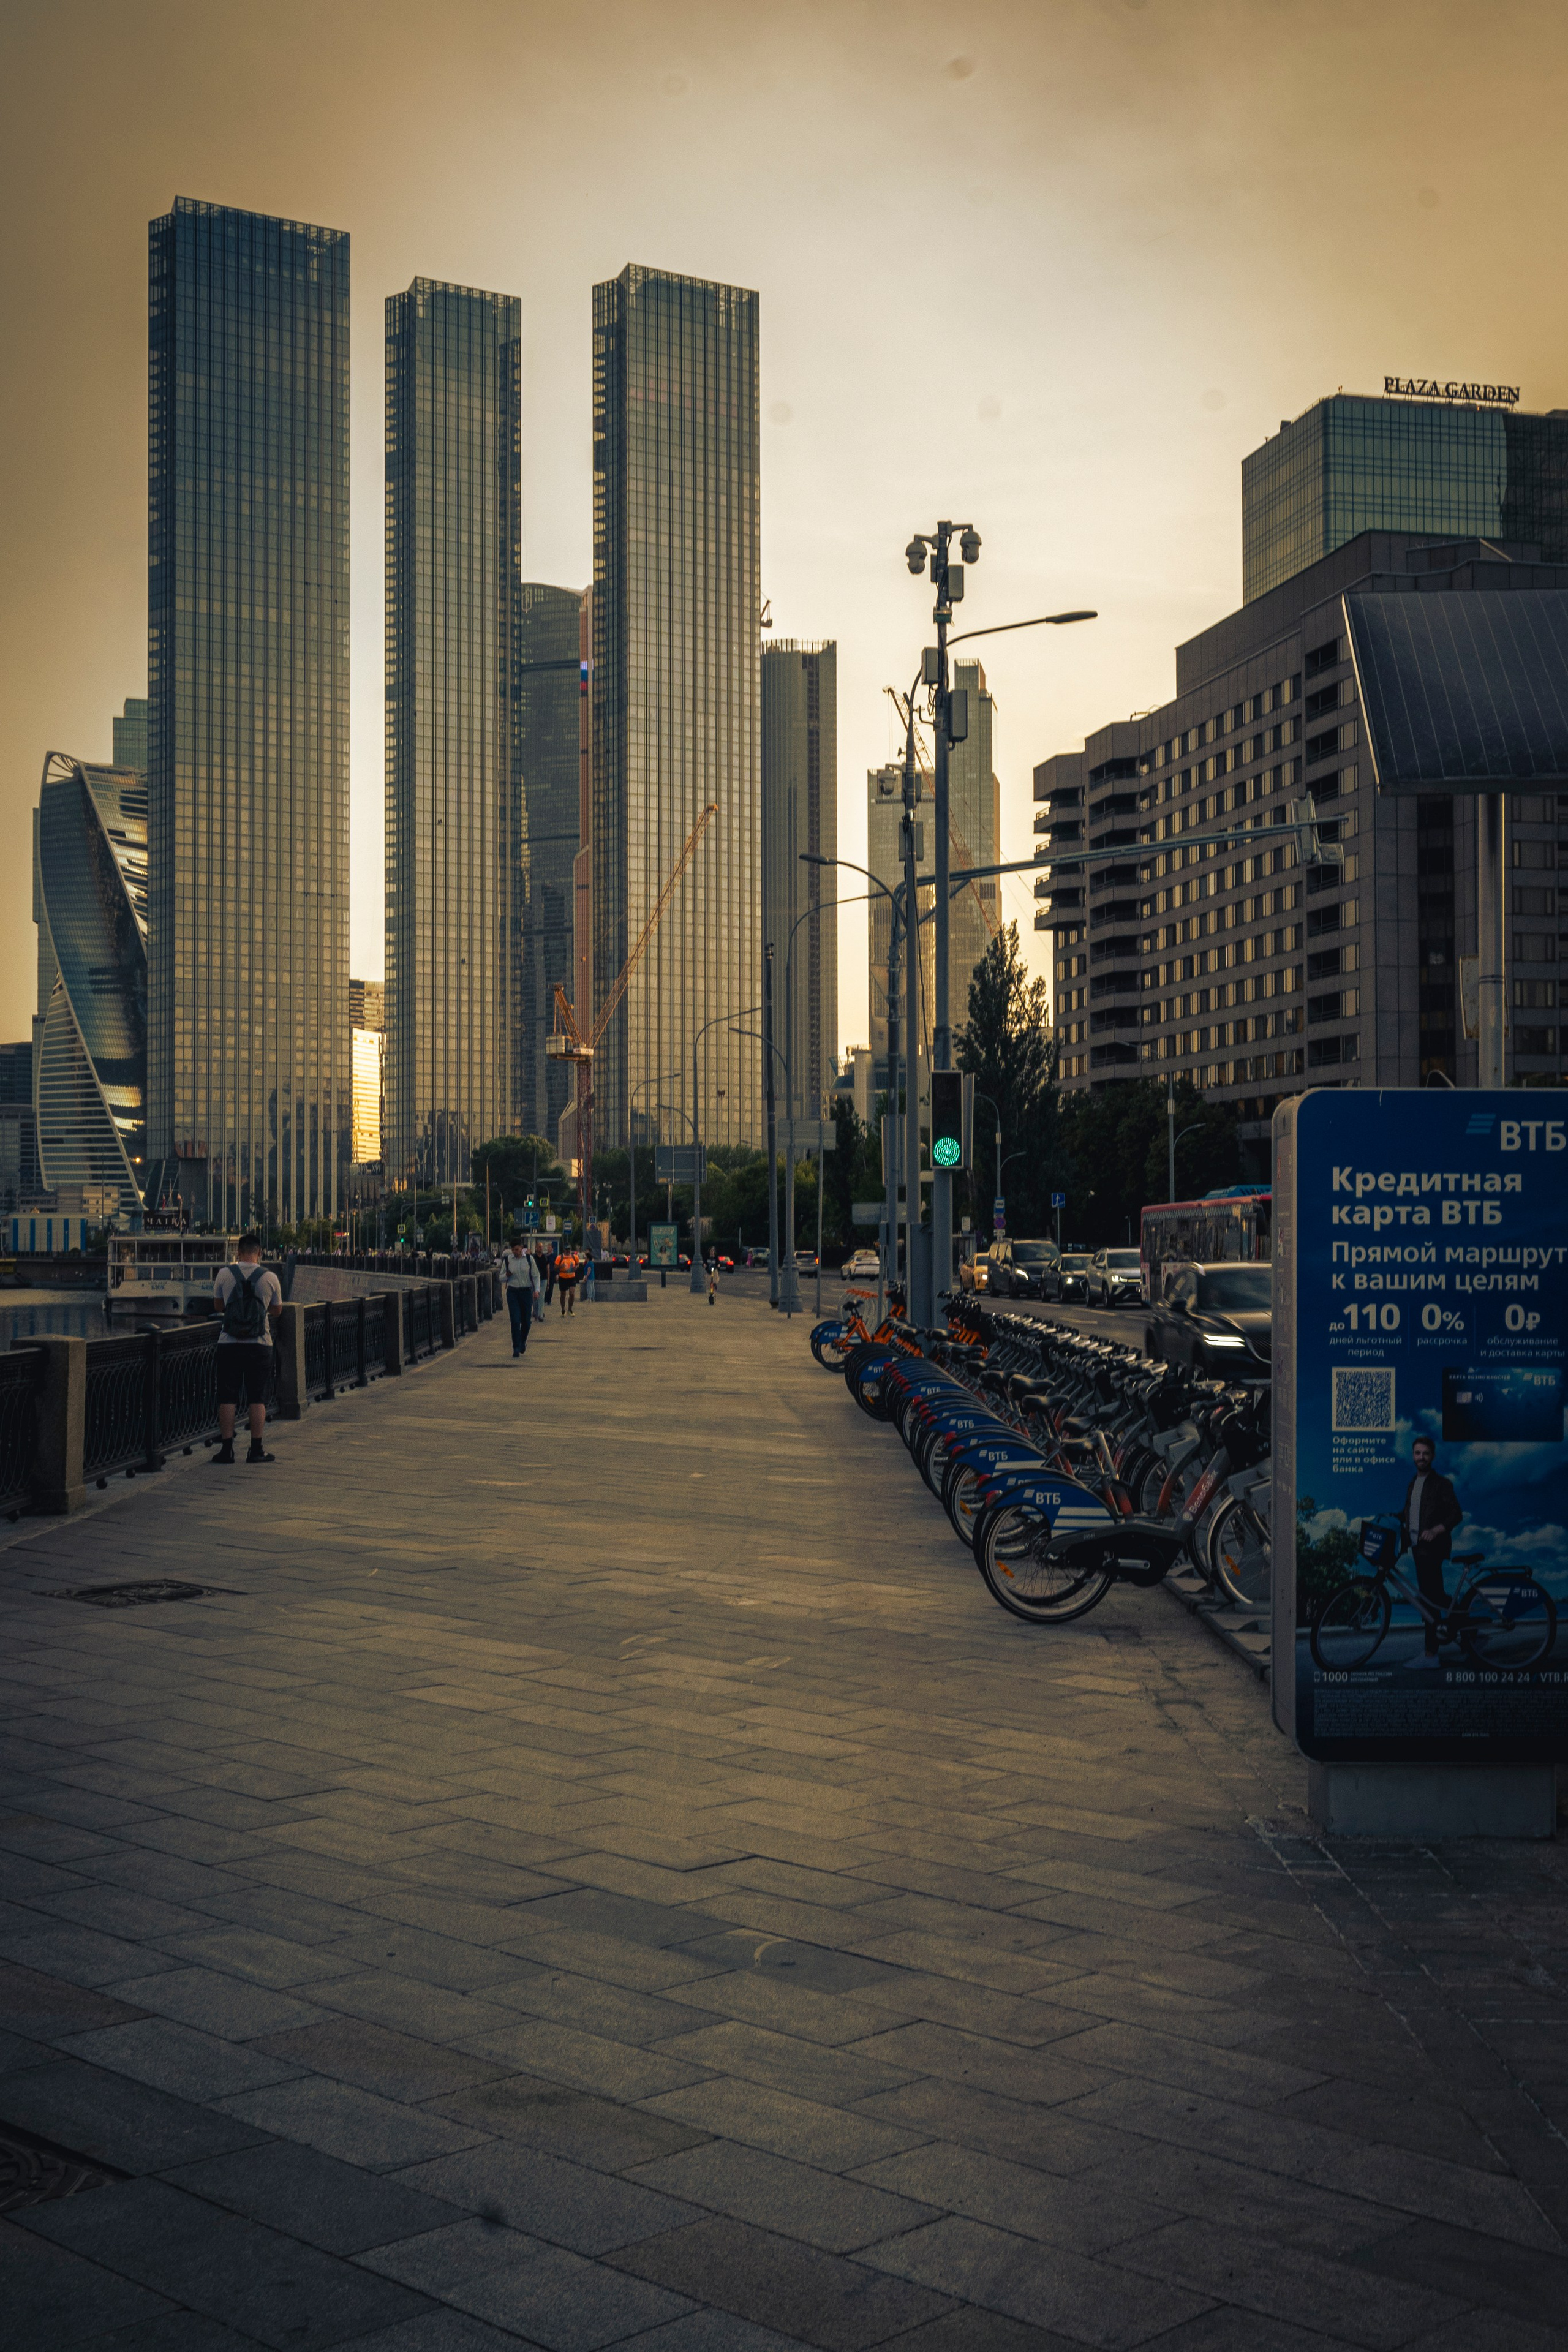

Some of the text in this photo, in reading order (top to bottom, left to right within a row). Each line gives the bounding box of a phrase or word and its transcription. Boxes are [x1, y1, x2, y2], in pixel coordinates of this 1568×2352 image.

[1384, 376, 1521, 402] PLAZA GARDEN
[1501, 1120, 1567, 1152] ВТБ
[1332, 1166, 1522, 1198] Кредитная
[1332, 1200, 1502, 1231] карта ВТБ
[1332, 1242, 1567, 1268] Прямой маршрут
[1332, 1273, 1539, 1293] к вашим целям
[1329, 1303, 1401, 1332] до 110
[1421, 1302, 1465, 1331] 0%
[1329, 1335, 1403, 1346] дней льготный
[1417, 1336, 1468, 1348] рассрочка
[1487, 1335, 1559, 1347] обслуживание
[1348, 1348, 1385, 1359] период
[1488, 1349, 1533, 1359] доставка
[1535, 1349, 1566, 1359] карты
[1533, 1374, 1556, 1387] ВТБ
[957, 1419, 974, 1429] ВТБ
[1332, 1435, 1387, 1446] Оформите
[988, 1450, 1008, 1461] ВТБ
[1347, 1446, 1376, 1454] сайте
[1363, 1455, 1396, 1466] офисе
[1332, 1463, 1363, 1474] банка
[1036, 1492, 1061, 1505] ВТБ
[1521, 1588, 1539, 1598] ВТБ
[1322, 1671, 1348, 1683] 1000
[1446, 1671, 1452, 1683] 8
[1455, 1671, 1476, 1683] 800
[1479, 1671, 1498, 1683] 100
[1501, 1671, 1514, 1683] 24
[1517, 1671, 1530, 1683] 24
